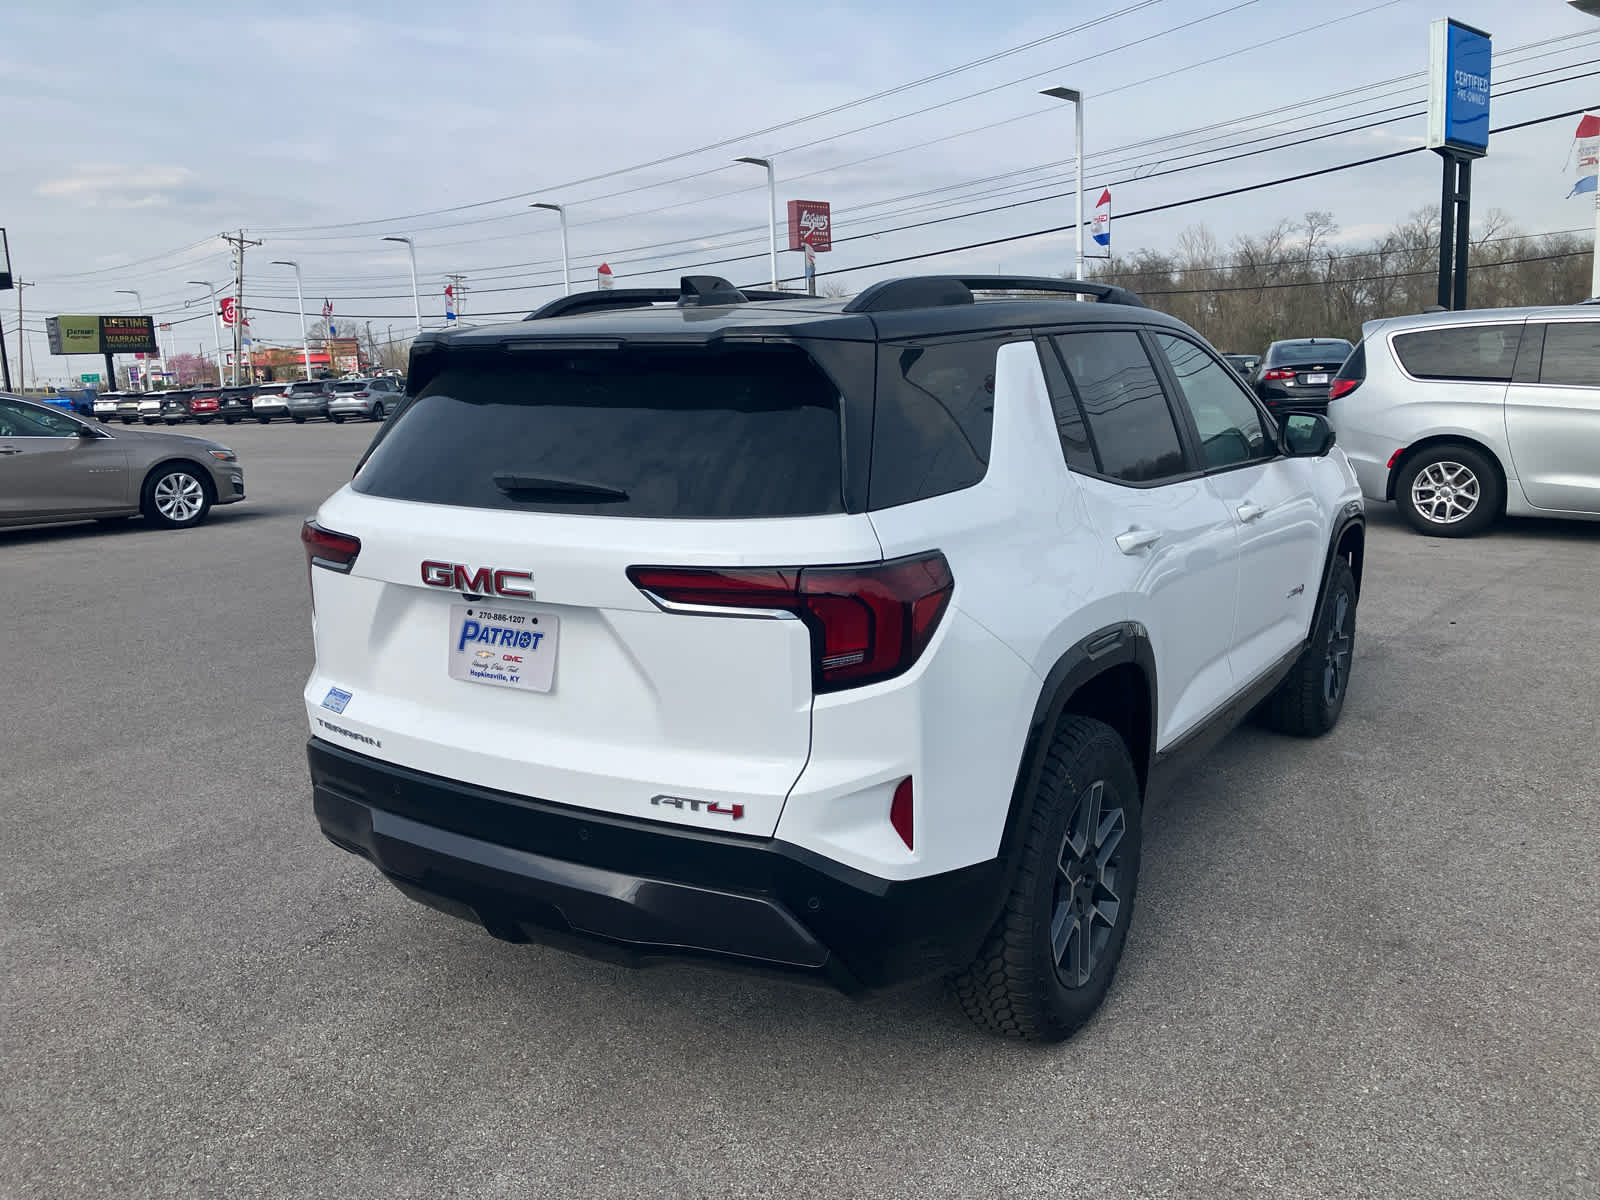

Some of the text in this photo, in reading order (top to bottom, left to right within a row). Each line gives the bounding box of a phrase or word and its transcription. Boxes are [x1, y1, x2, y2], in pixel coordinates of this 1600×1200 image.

[1454, 70, 1488, 92] CERTIFIED
[103, 317, 148, 329] LIFETIME
[105, 335, 149, 344] WARRANTY
[421, 559, 537, 600] GMC
[478, 611, 526, 624] 270-886-1207
[457, 620, 544, 652] PATRIOT
[502, 654, 523, 663] GMC
[470, 669, 520, 683] Hopkinsville, KY
[316, 717, 382, 748] TERRAIN
[651, 794, 744, 820] AT4
